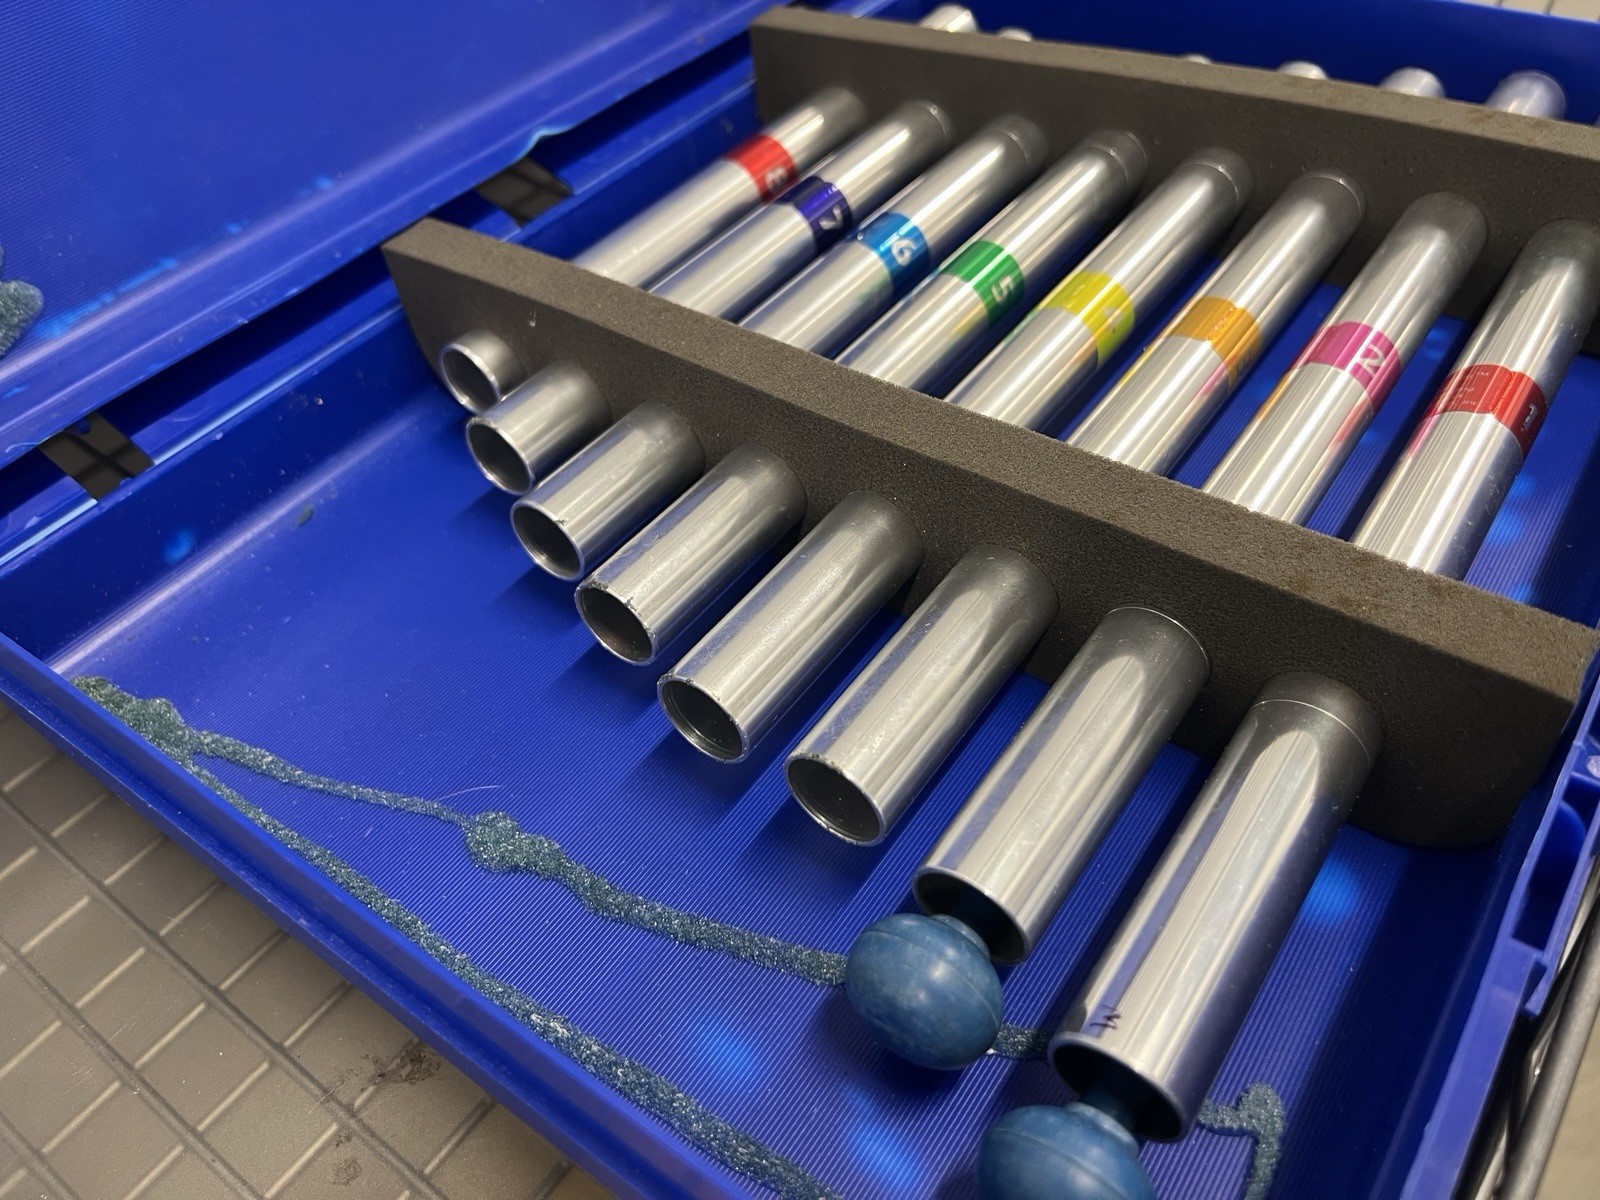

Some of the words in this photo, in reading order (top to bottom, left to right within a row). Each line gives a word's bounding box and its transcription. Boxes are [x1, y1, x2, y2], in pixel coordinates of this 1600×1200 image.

[818, 206, 843, 230] 7
[891, 239, 916, 266] 6
[991, 275, 1015, 306] 5
[1358, 344, 1385, 379] 2
